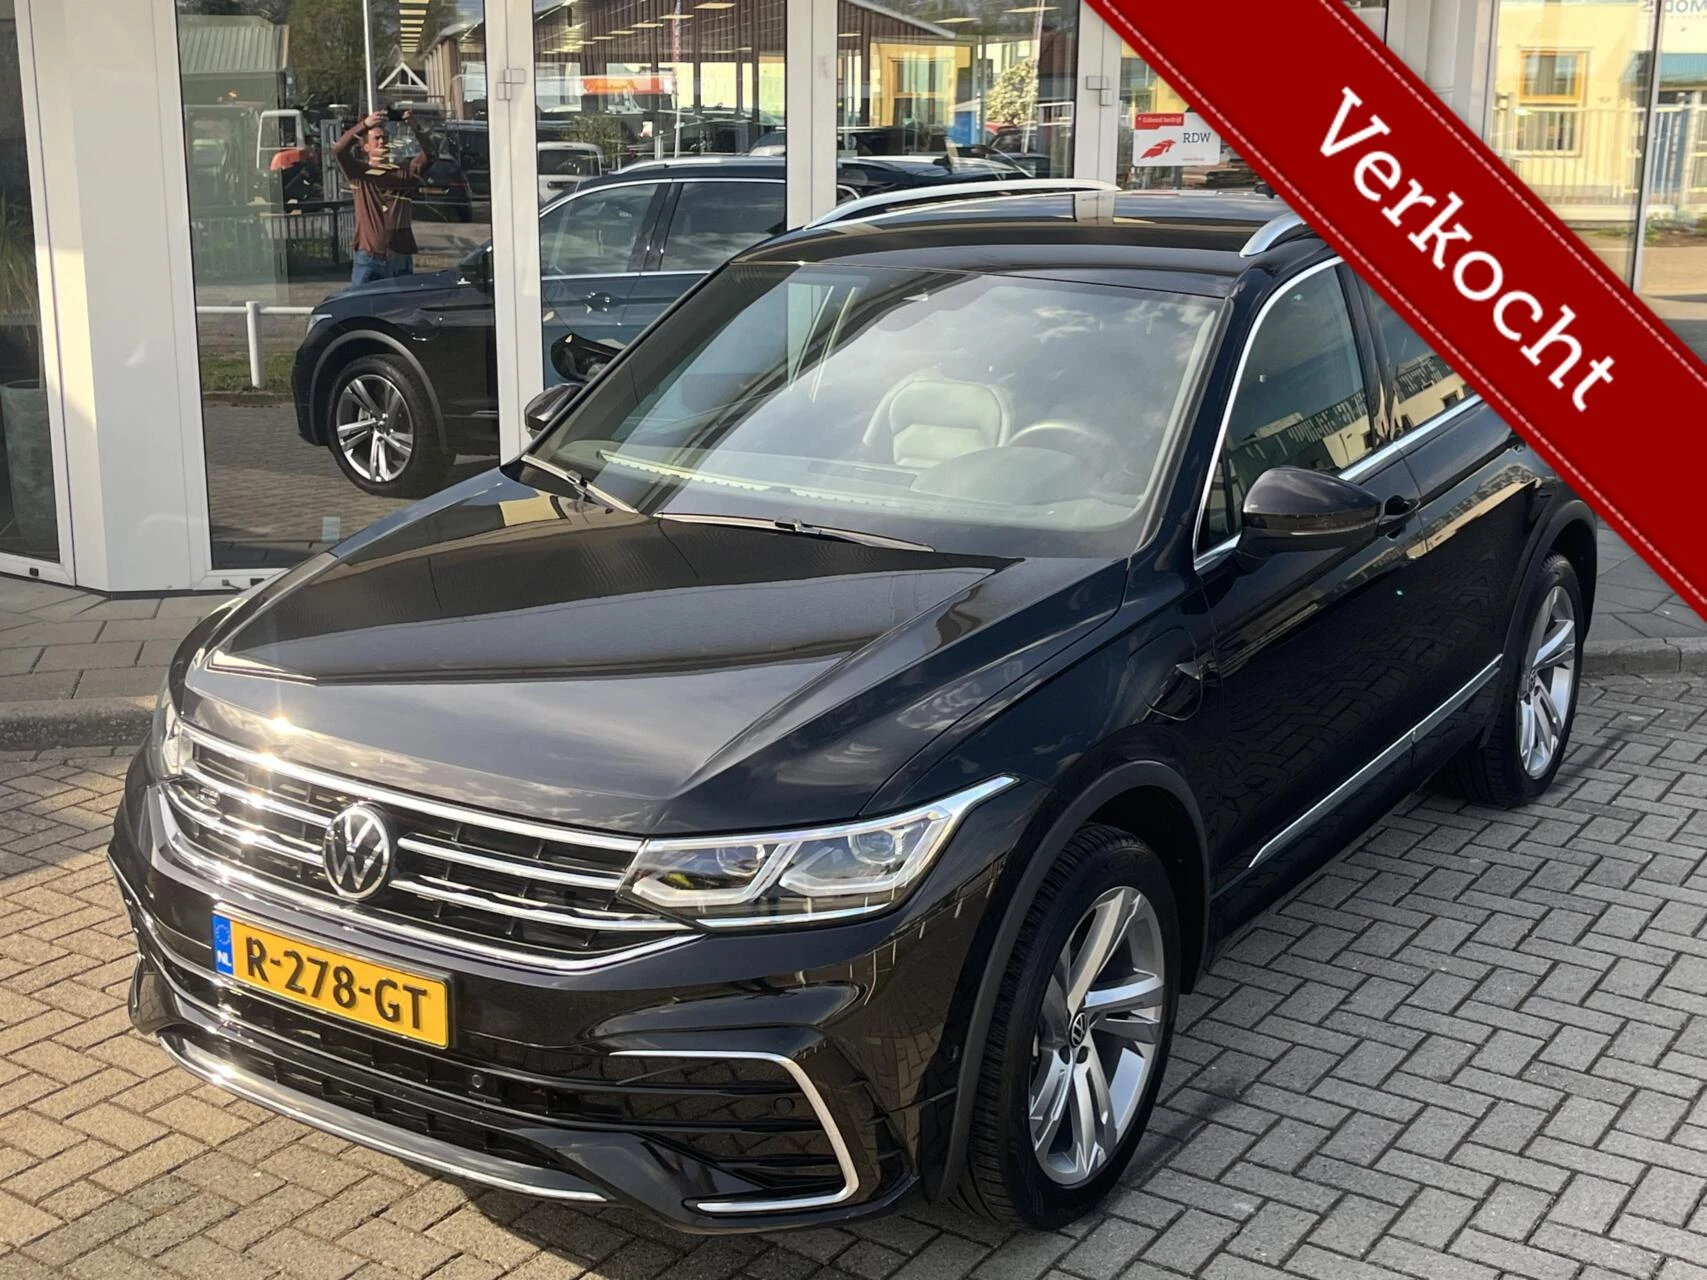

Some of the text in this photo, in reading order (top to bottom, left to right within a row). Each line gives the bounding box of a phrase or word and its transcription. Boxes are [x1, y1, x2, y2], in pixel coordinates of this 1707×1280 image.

[1183, 132, 1211, 143] RDW
[217, 950, 232, 967] NL
[246, 936, 428, 1030] R-278-GT
